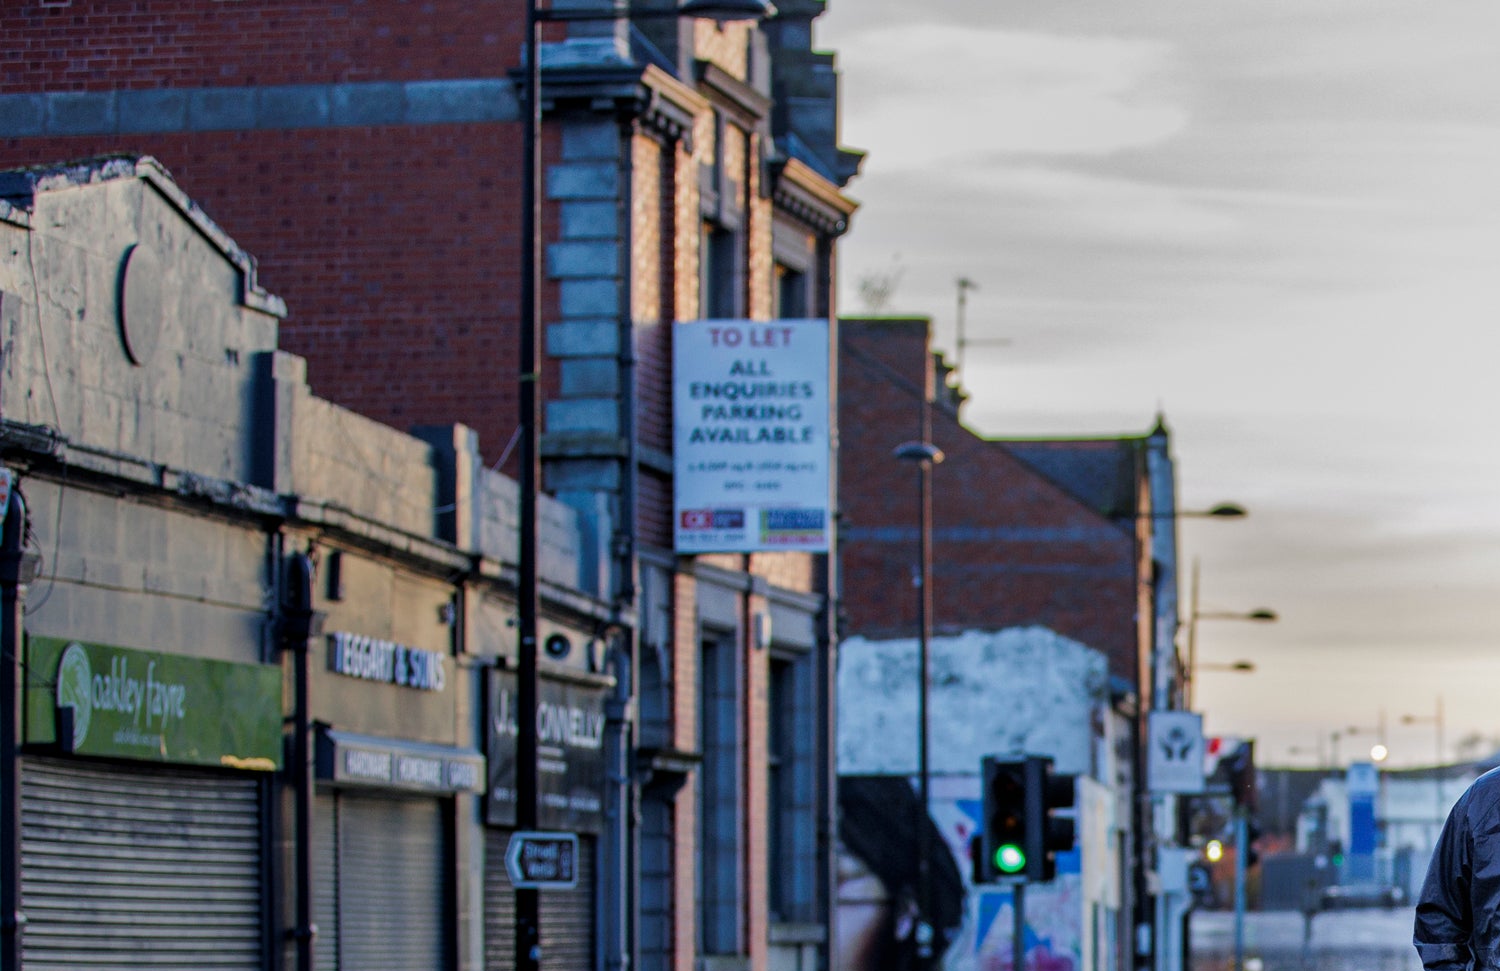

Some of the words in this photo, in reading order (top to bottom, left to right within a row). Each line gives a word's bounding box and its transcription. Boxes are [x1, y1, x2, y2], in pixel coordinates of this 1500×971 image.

[709, 327, 742, 348] TO
[750, 327, 793, 348] LET
[730, 359, 770, 376] ALL
[689, 381, 813, 400] ENQUIRIES
[701, 404, 802, 421] PARKING
[689, 426, 812, 445] AVAILABLE
[394, 642, 409, 686] &
[409, 647, 446, 691] SONS
[92, 655, 142, 725] oakley
[146, 659, 186, 728] fayre
